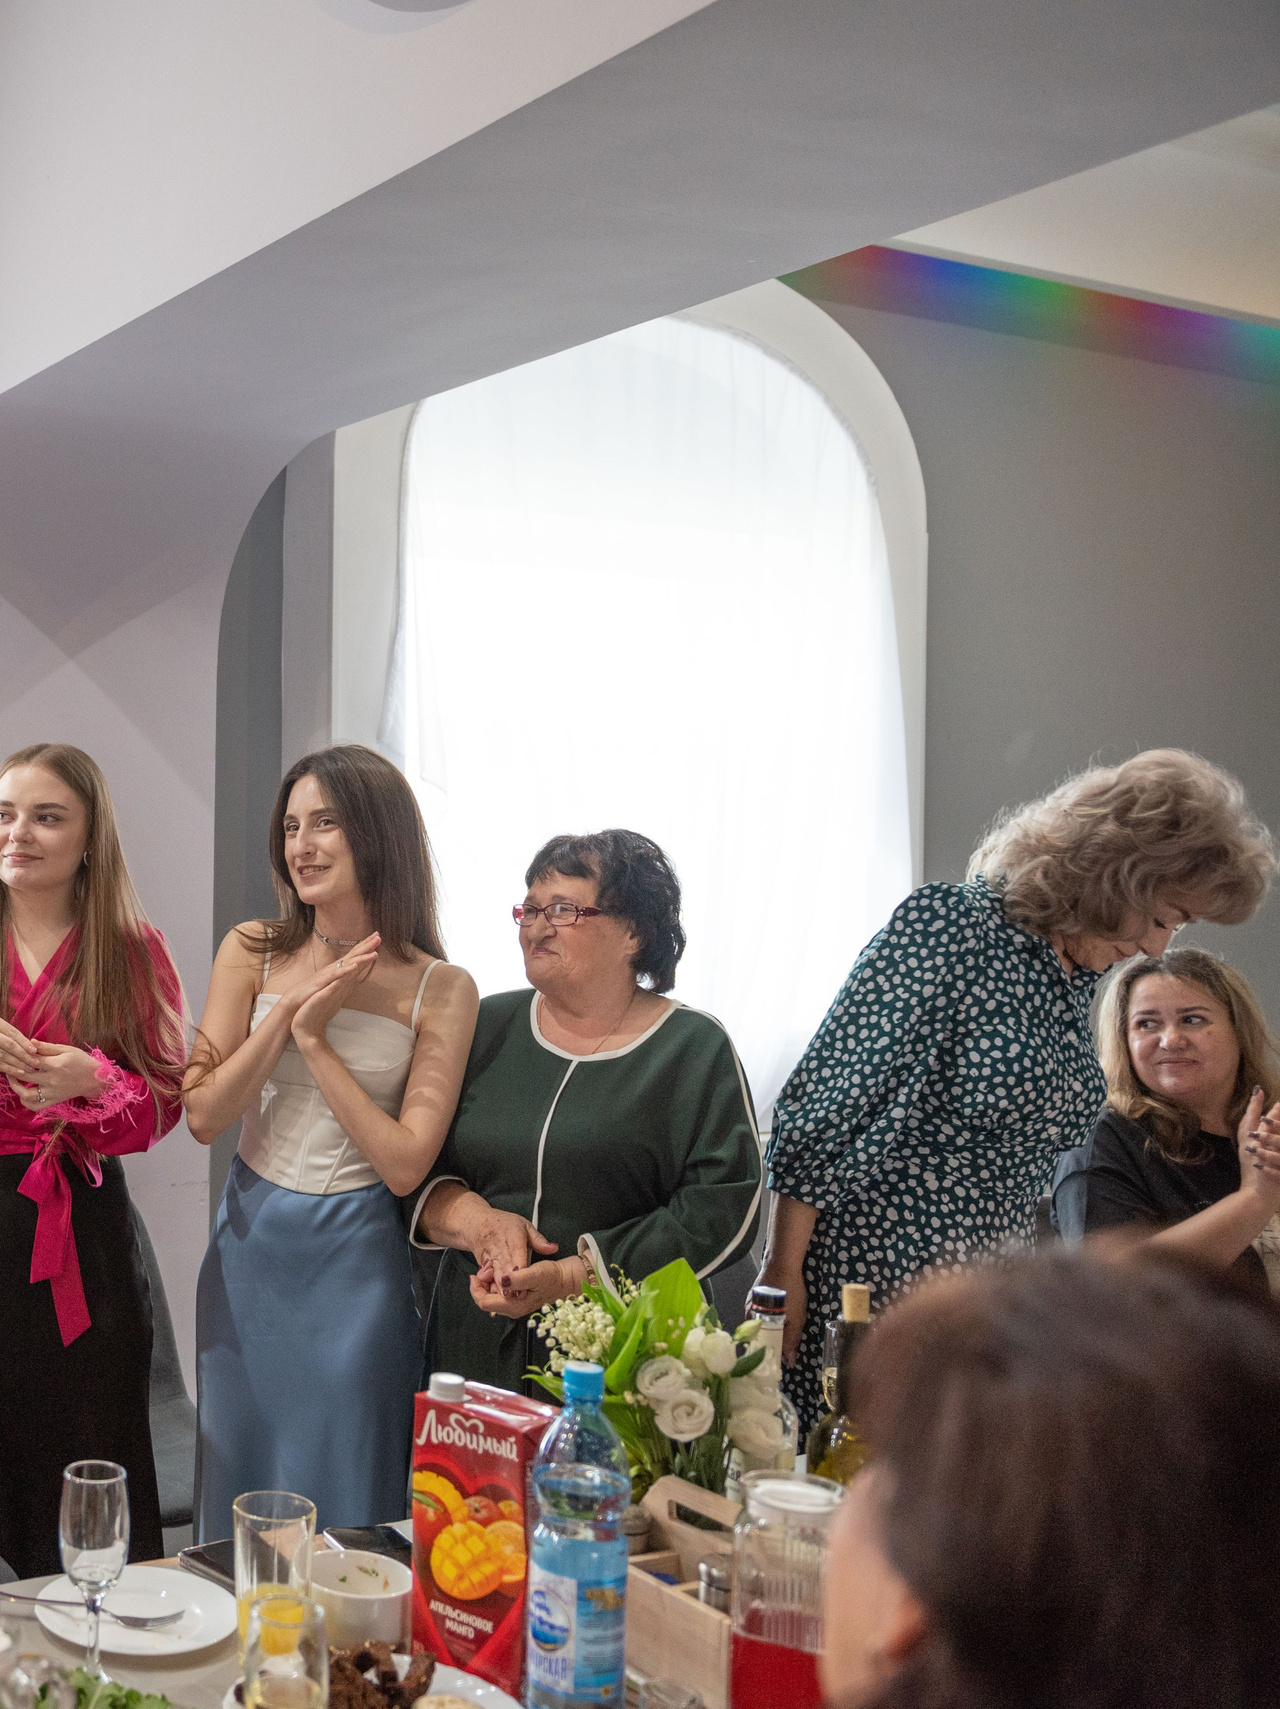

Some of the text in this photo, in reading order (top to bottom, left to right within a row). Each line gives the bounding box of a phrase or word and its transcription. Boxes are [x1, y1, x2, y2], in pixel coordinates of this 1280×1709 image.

[415, 1408, 519, 1463] Любимый
[428, 1599, 494, 1634] АПЕЛЬСИНОВОЕ
[445, 1617, 475, 1639] МАНГО
